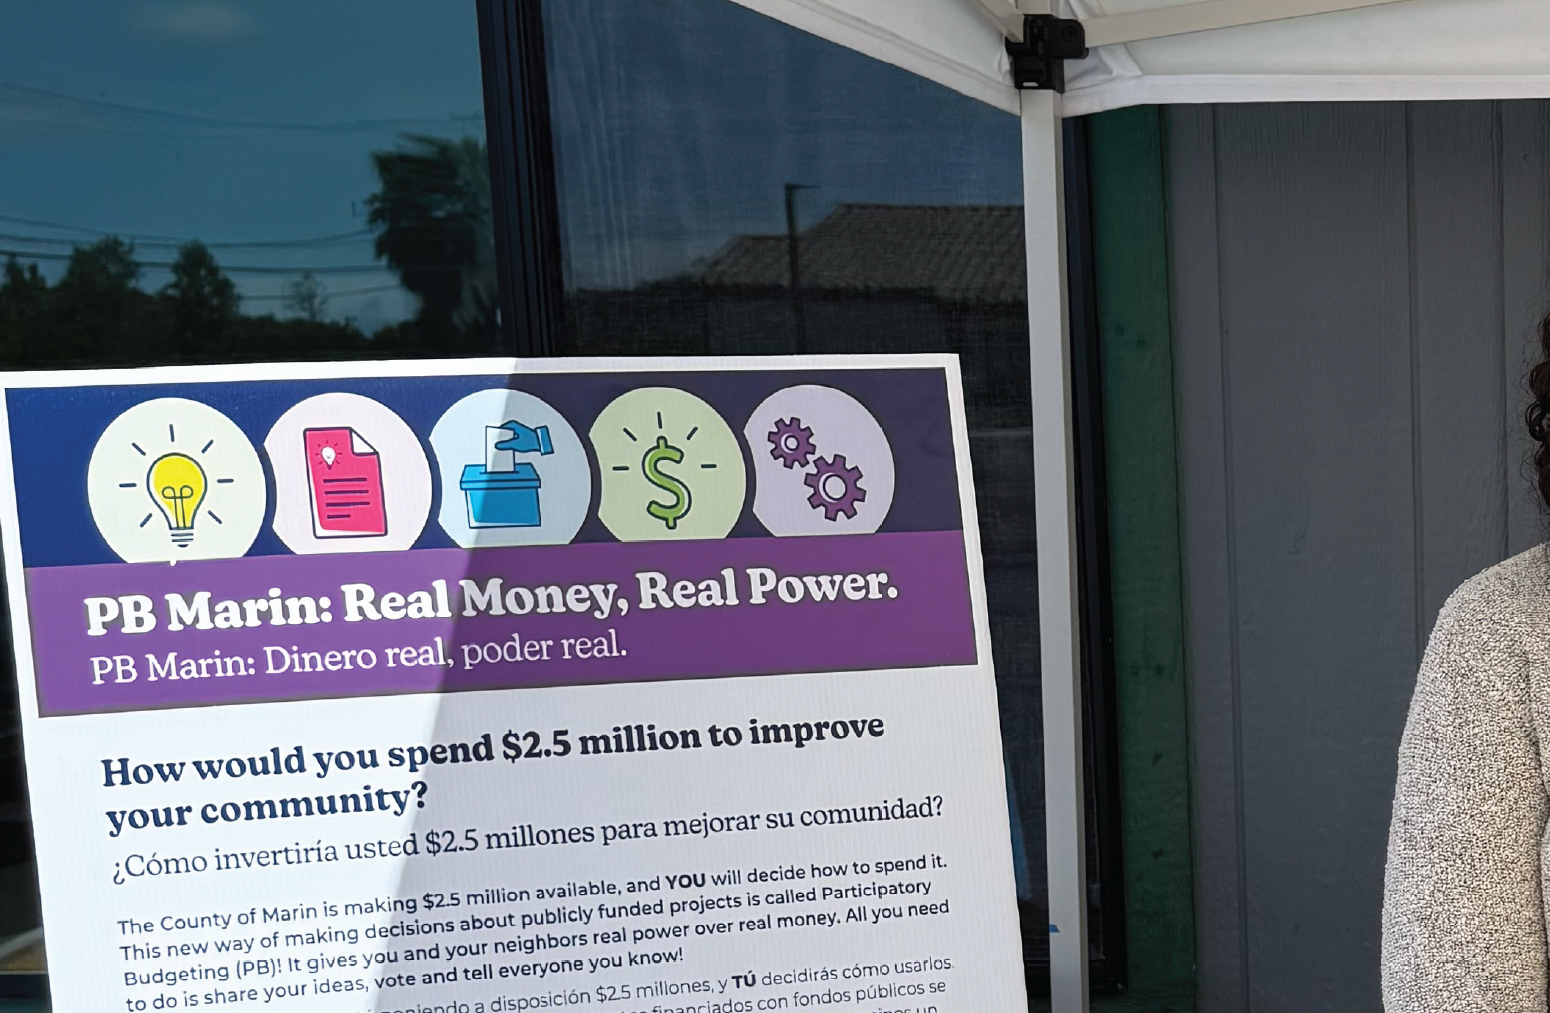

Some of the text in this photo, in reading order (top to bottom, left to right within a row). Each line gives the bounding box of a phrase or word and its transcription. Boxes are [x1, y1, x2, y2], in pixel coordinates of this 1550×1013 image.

[83, 567, 898, 637] PB Marin: Real Money, Real Power.
[89, 628, 627, 685] PB Marin: Dinero real, poder real.
[100, 718, 885, 788] How would you spend $2.5 million to improve
[105, 780, 429, 838] your community?
[113, 795, 943, 886] ¿Cómo invertiría usted $2.5 millones para mejorar su comunidad?
[117, 853, 947, 935] The County of Marin is making $2.5 million available, and YOU will decide how to spend it.
[474, 1002, 485, 1013] a
[490, 989, 591, 1013] disposición
[636, 980, 714, 999] millones,
[717, 978, 728, 995] y
[730, 973, 757, 989] TÚ
[761, 966, 838, 986] decidirás
[842, 962, 890, 980] cómo
[894, 955, 954, 974] usarlos.
